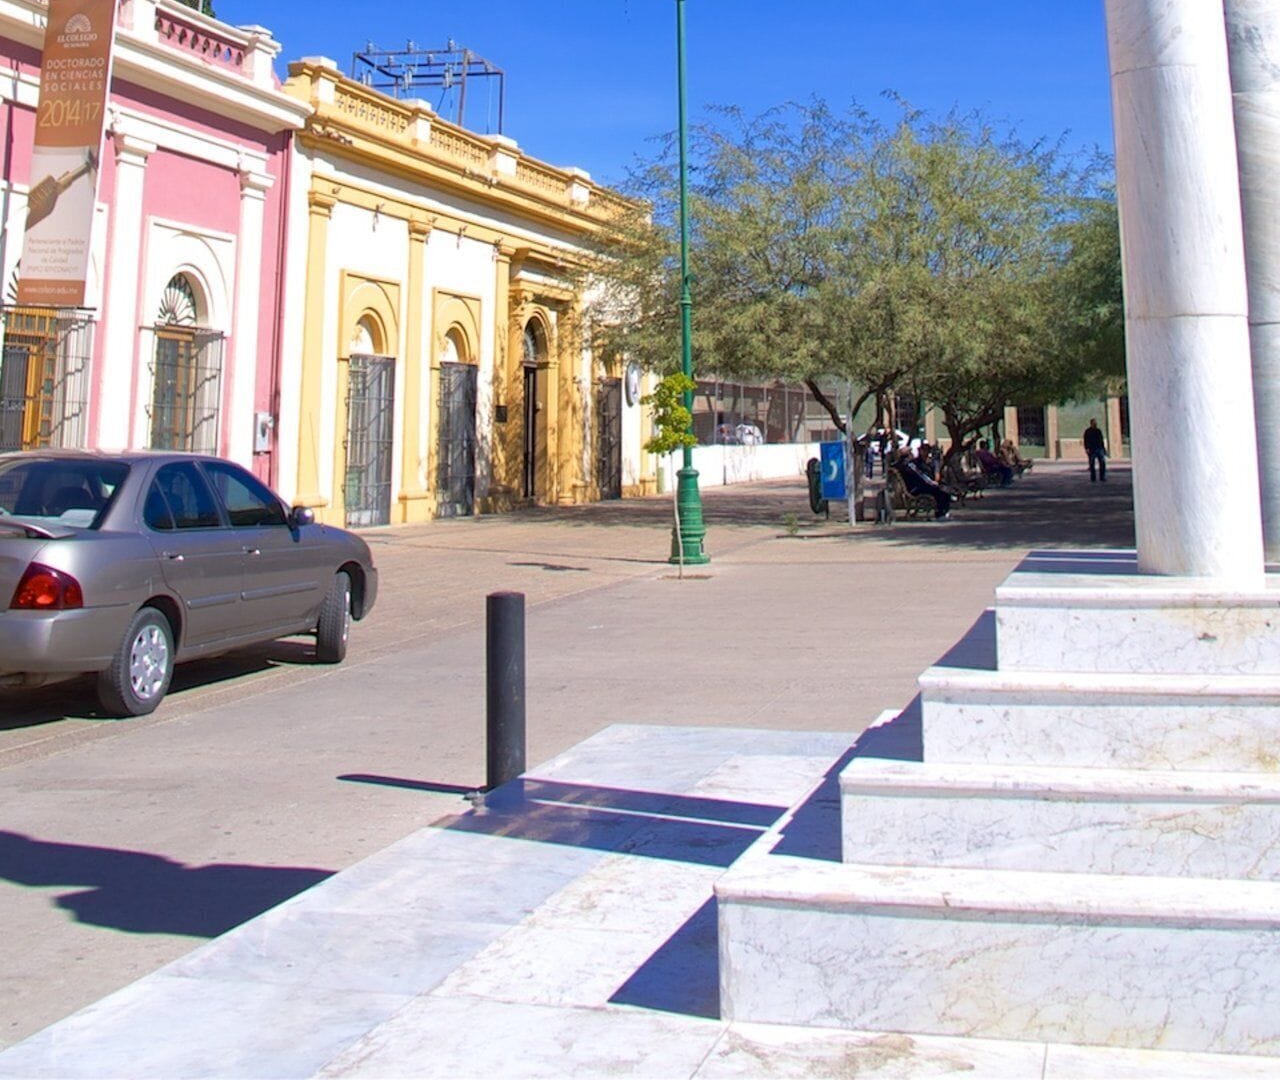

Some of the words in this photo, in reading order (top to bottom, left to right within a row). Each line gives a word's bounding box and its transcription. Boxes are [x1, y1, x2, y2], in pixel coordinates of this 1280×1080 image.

[65, 33, 98, 43] COLEGIO
[46, 57, 105, 70] DOCTORADO
[45, 71, 58, 81] EN
[60, 68, 104, 81] CIENCIAS
[44, 81, 103, 92] SOCIALES
